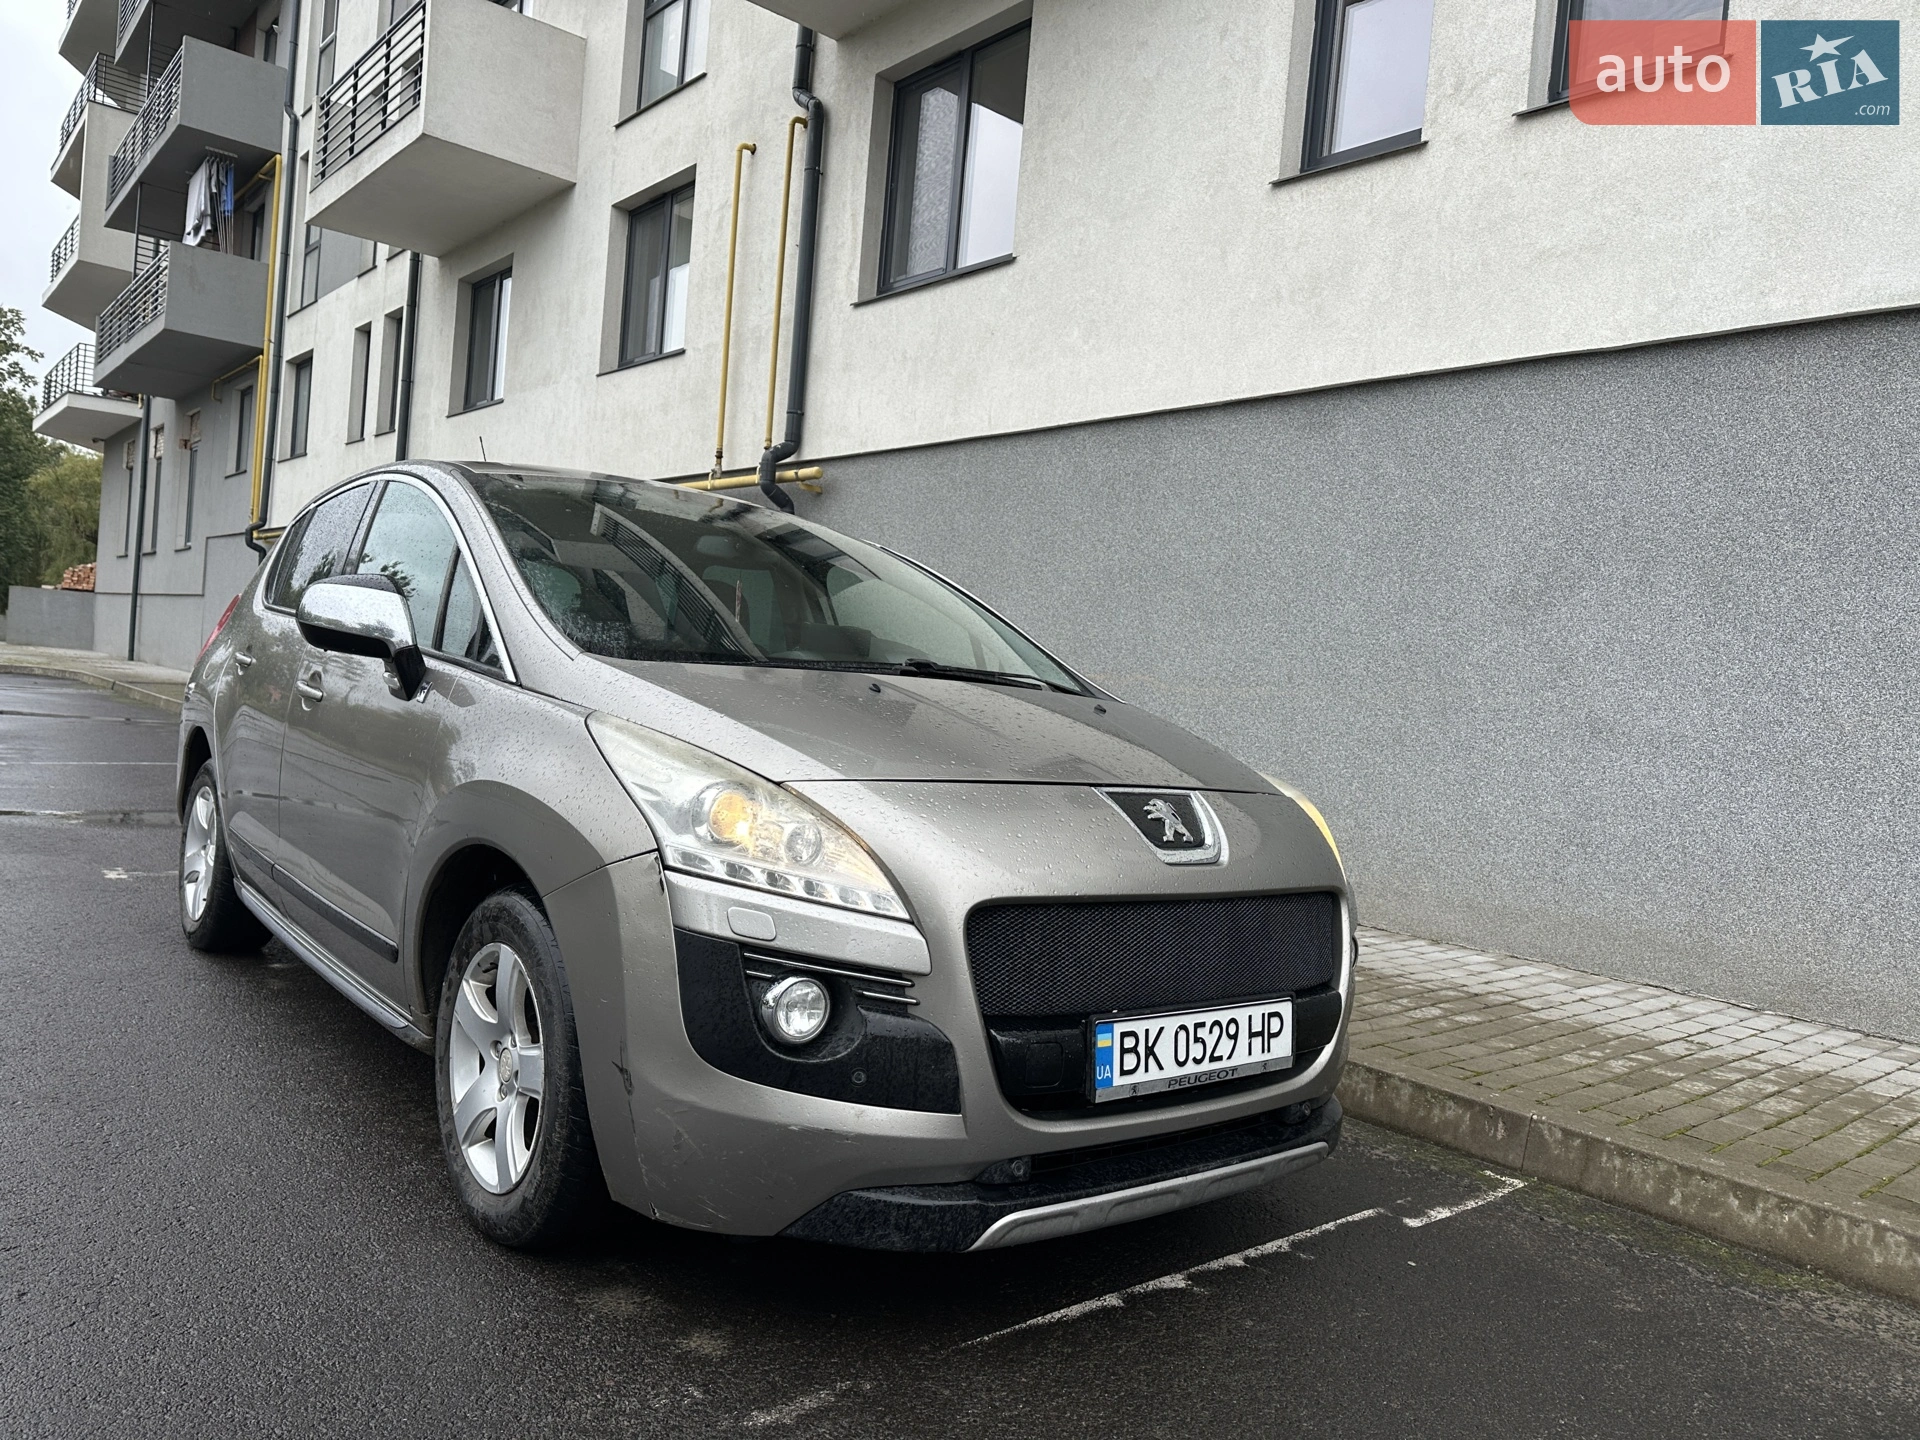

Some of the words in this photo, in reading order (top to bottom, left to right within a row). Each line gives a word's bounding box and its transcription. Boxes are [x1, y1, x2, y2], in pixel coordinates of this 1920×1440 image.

[1119, 1026, 1165, 1077] BK
[1173, 1017, 1239, 1067] 0529
[1248, 1011, 1284, 1056] HP
[1096, 1065, 1111, 1080] UA
[1167, 1069, 1238, 1089] PEUGEOT
